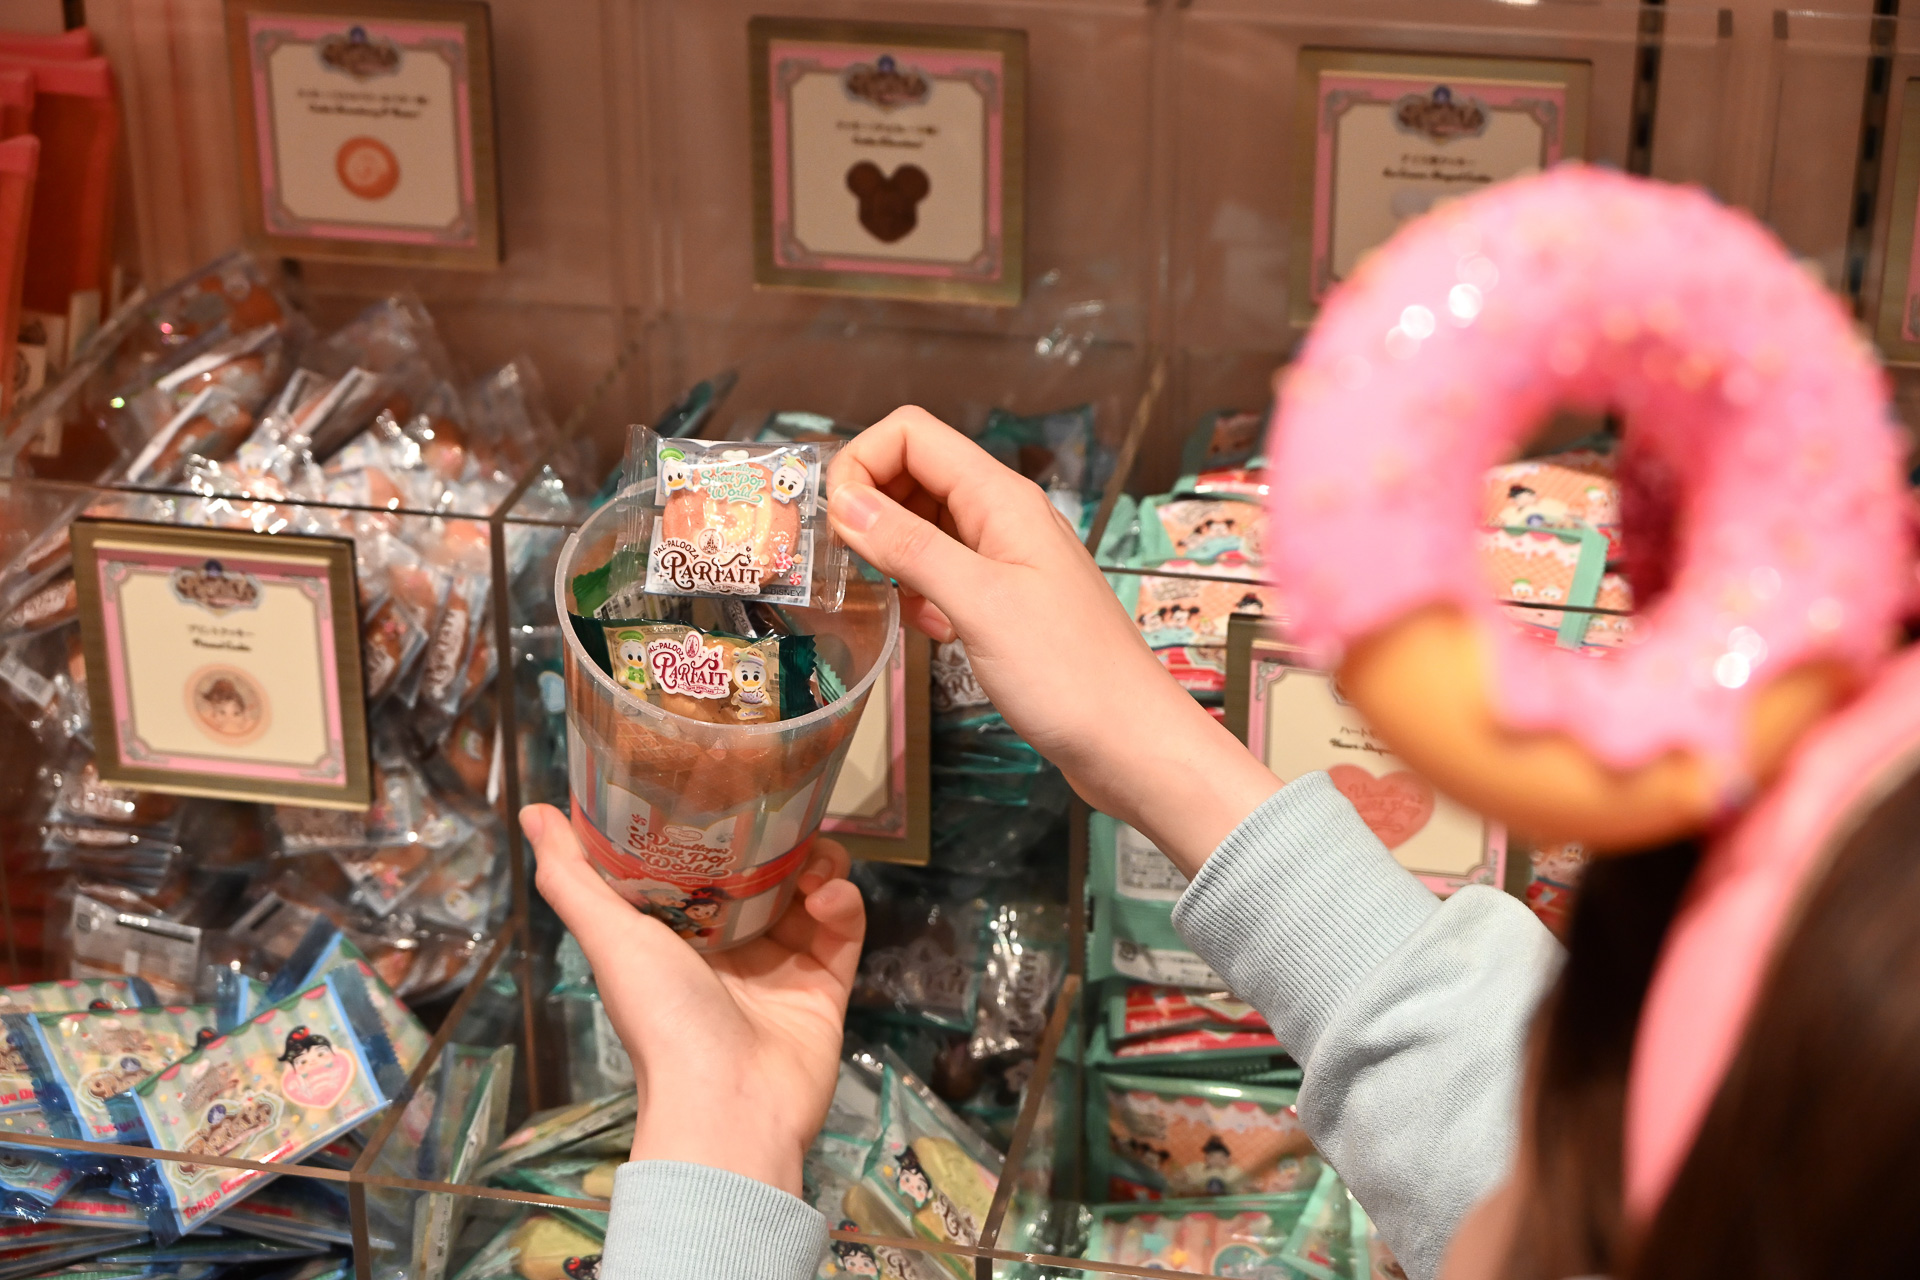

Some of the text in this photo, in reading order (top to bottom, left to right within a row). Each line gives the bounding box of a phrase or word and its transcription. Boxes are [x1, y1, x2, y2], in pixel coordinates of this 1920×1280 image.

[700, 470, 766, 491] Sweet Pop
[708, 484, 763, 503] World
[653, 540, 700, 560] PAL-PALOOZA
[660, 549, 760, 590] PARFAIT
[771, 588, 801, 596] DISNEY
[653, 651, 728, 689] PARFAIT
[628, 833, 734, 867] Sweet Pop
[640, 852, 730, 878] World
[184, 1190, 221, 1219] Tokyo
